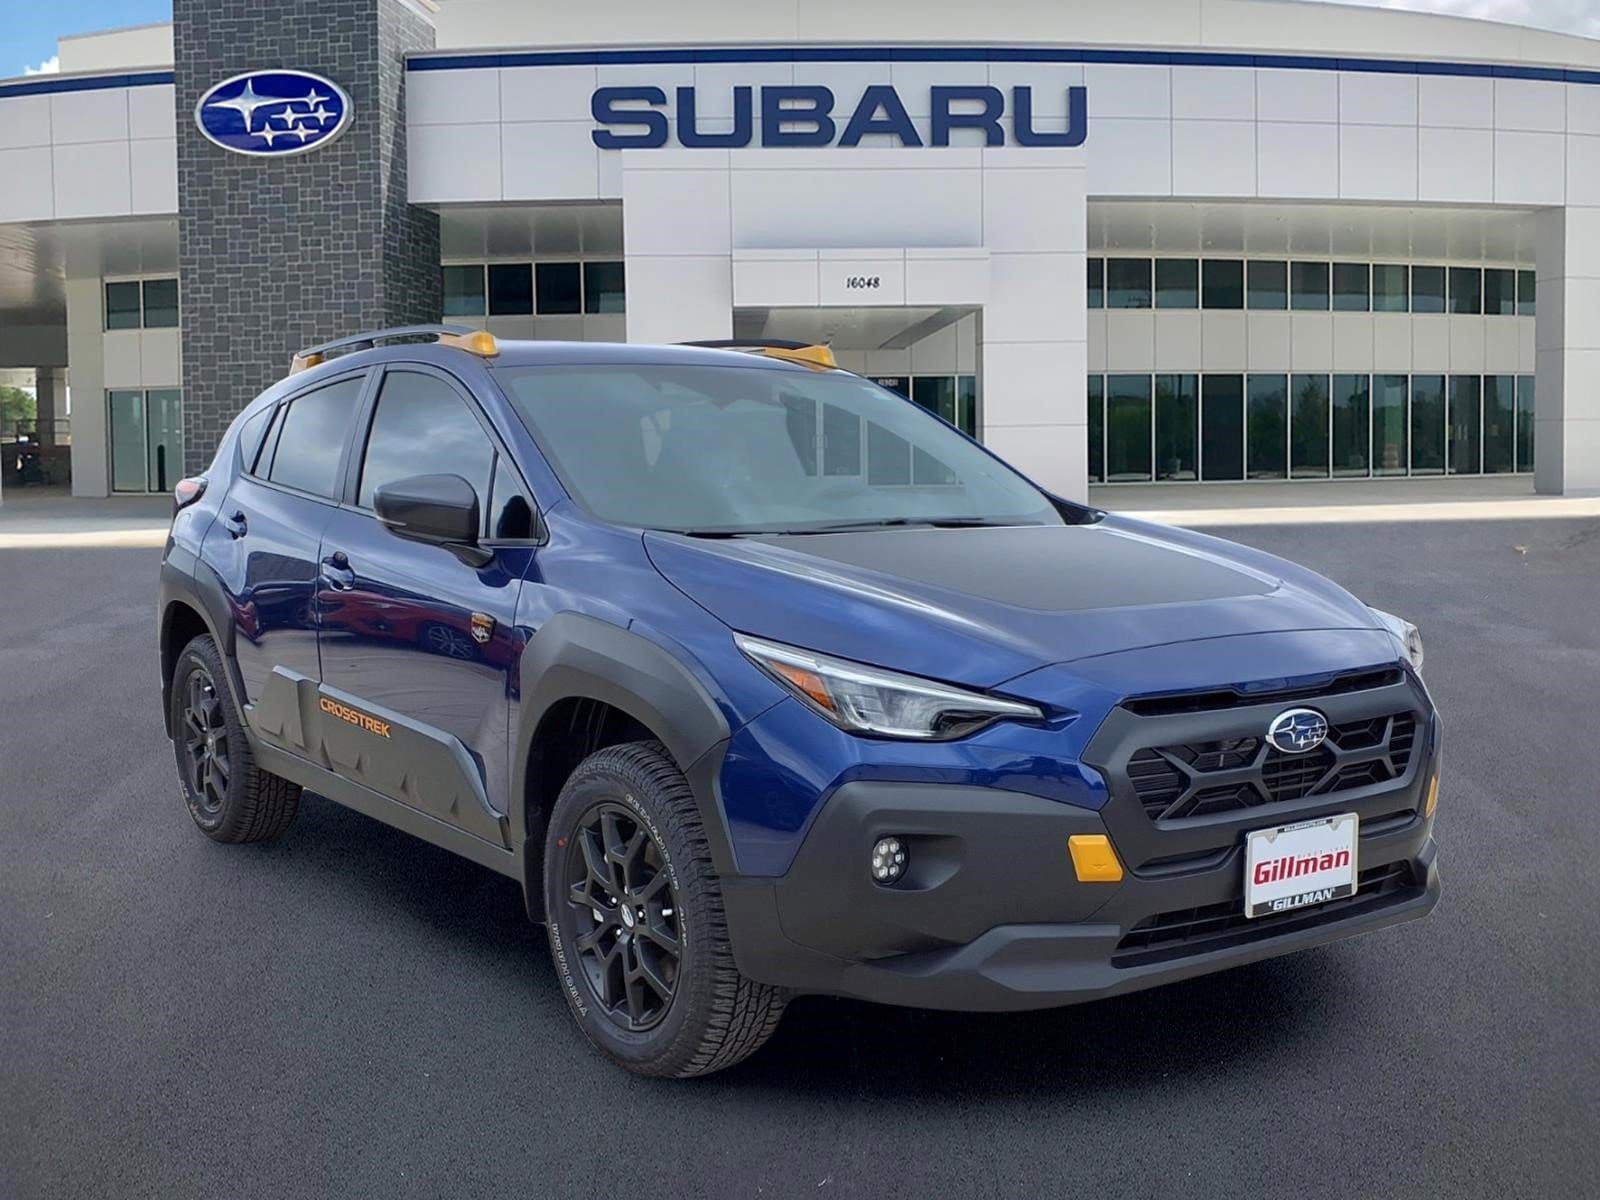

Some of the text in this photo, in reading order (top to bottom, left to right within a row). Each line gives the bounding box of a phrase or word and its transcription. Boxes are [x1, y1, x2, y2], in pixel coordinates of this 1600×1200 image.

[591, 85, 1088, 149] SUBARU
[846, 276, 880, 289] 16048
[320, 698, 391, 738] CROSSTREK
[1253, 850, 1350, 885] Gillman
